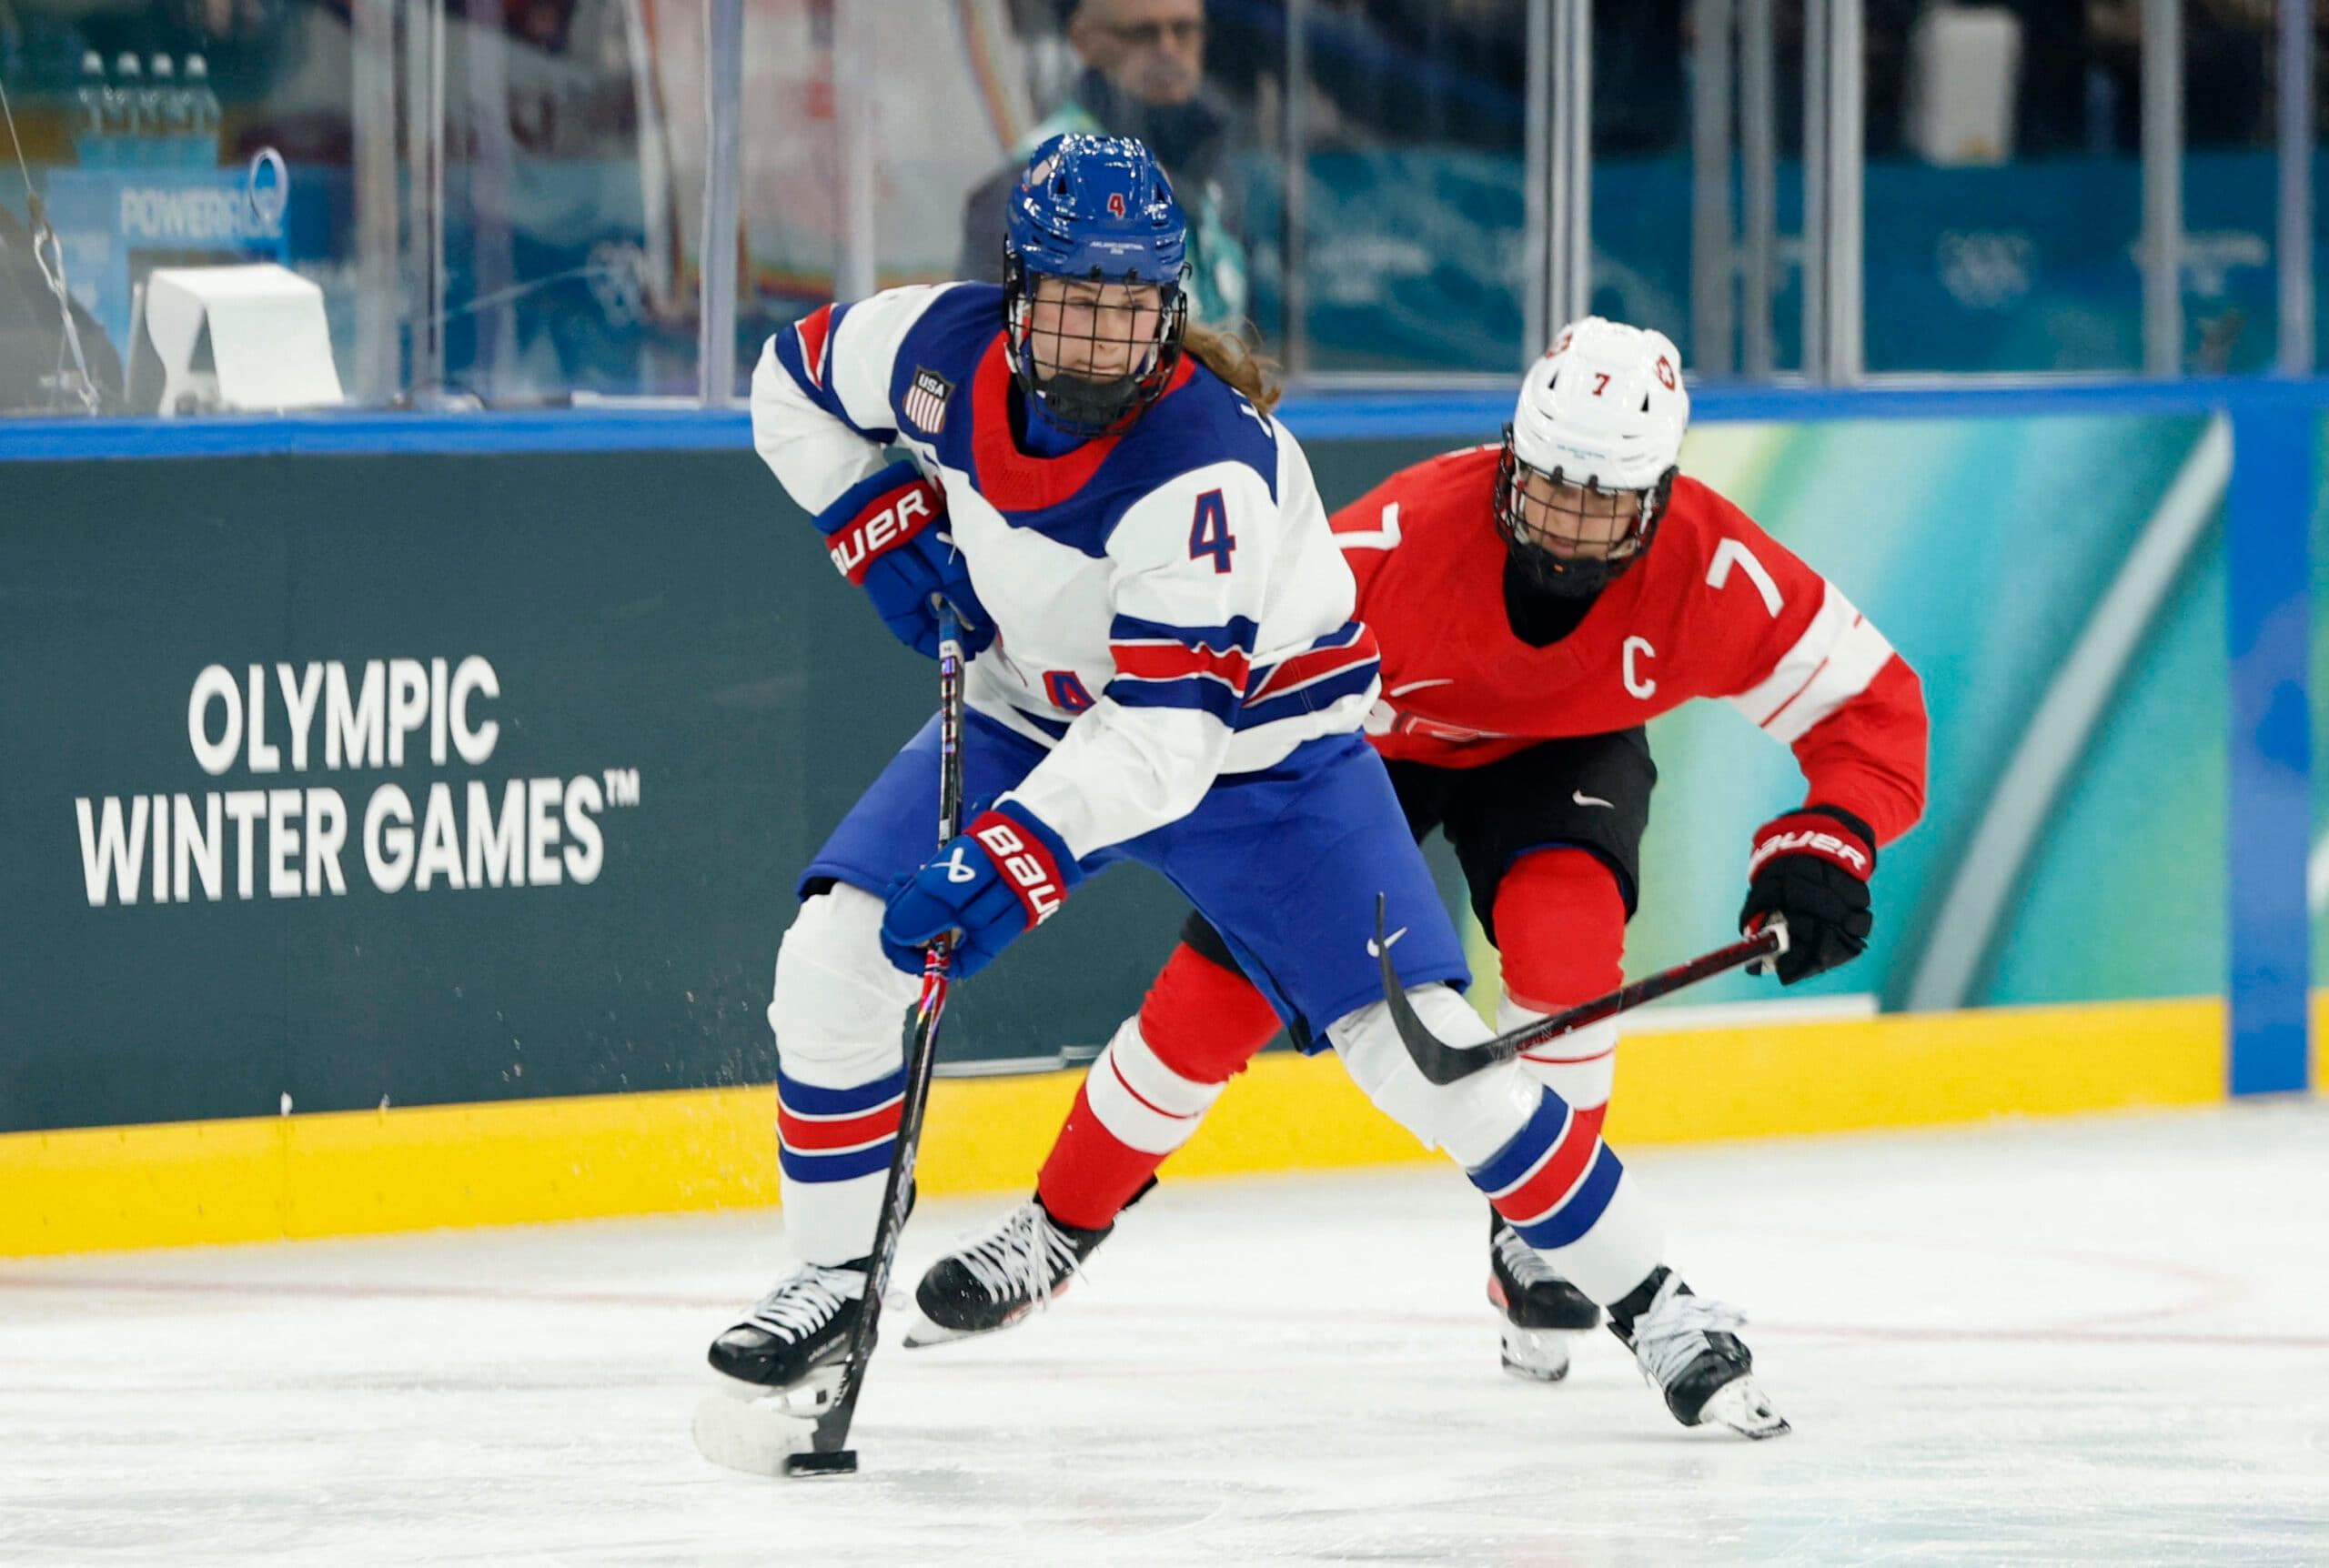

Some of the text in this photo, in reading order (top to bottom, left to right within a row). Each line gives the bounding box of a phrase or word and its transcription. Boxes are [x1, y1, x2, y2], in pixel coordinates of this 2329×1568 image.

[1107, 193, 1125, 219] 4
[918, 374, 944, 397] USA
[1592, 372, 1611, 397] 7
[1189, 487, 1236, 574] 4
[1706, 538, 1785, 618] 7
[1623, 635, 1657, 699] C
[187, 655, 500, 775] OLYMPIC
[75, 787, 348, 907] WINTER
